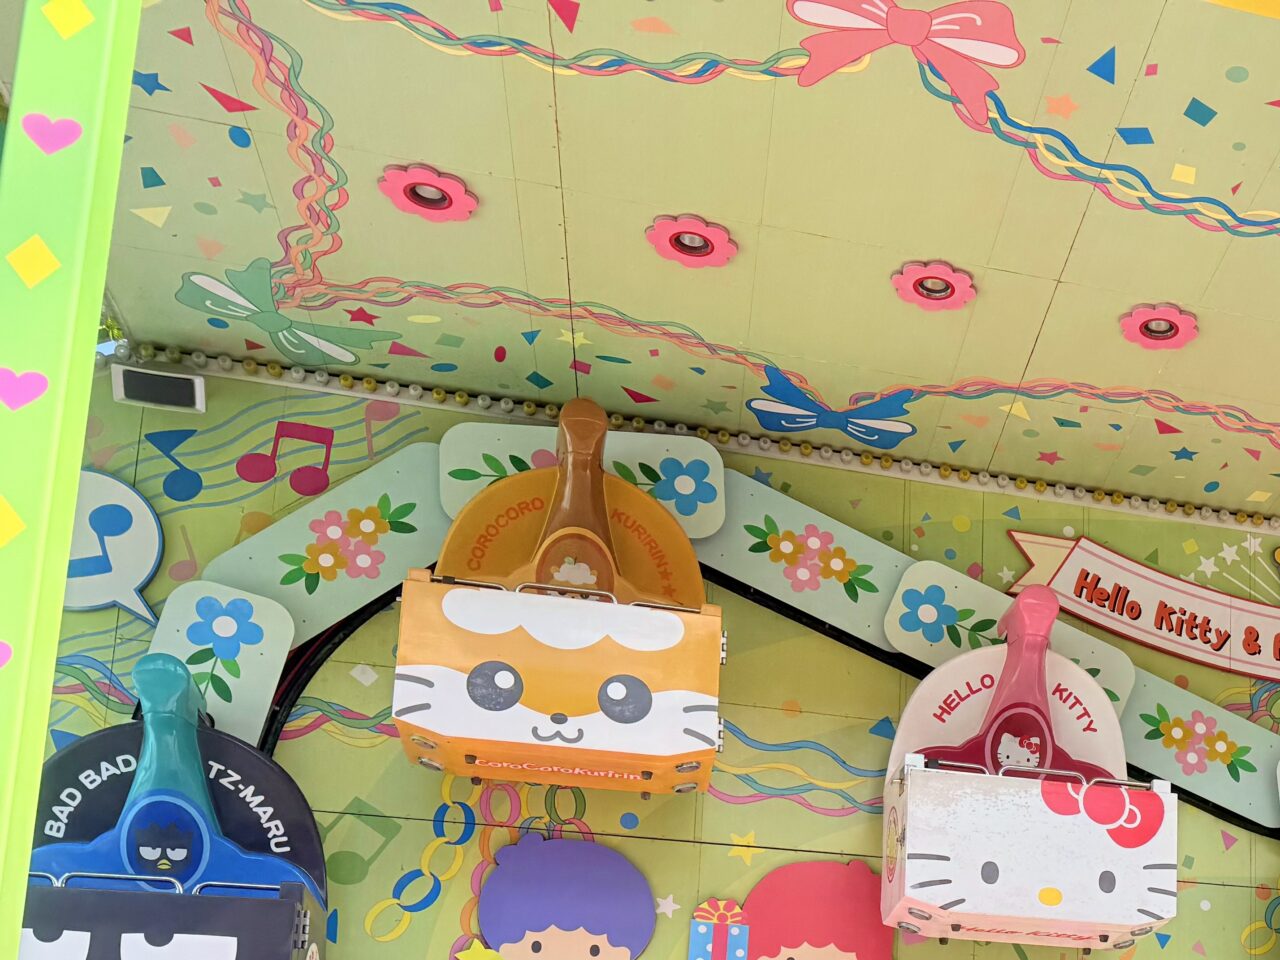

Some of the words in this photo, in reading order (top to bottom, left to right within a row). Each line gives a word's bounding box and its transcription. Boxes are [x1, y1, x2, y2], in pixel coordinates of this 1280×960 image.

[467, 497, 545, 572] COROCORO
[1073, 568, 1142, 620] Hello
[1153, 600, 1231, 651] Kitty
[1242, 625, 1262, 655] &
[932, 673, 995, 723] HELLO
[1052, 682, 1097, 734] KITTY
[44, 787, 82, 839] BAD
[78, 754, 137, 790] BAD
[207, 760, 291, 853] TZ-MARU
